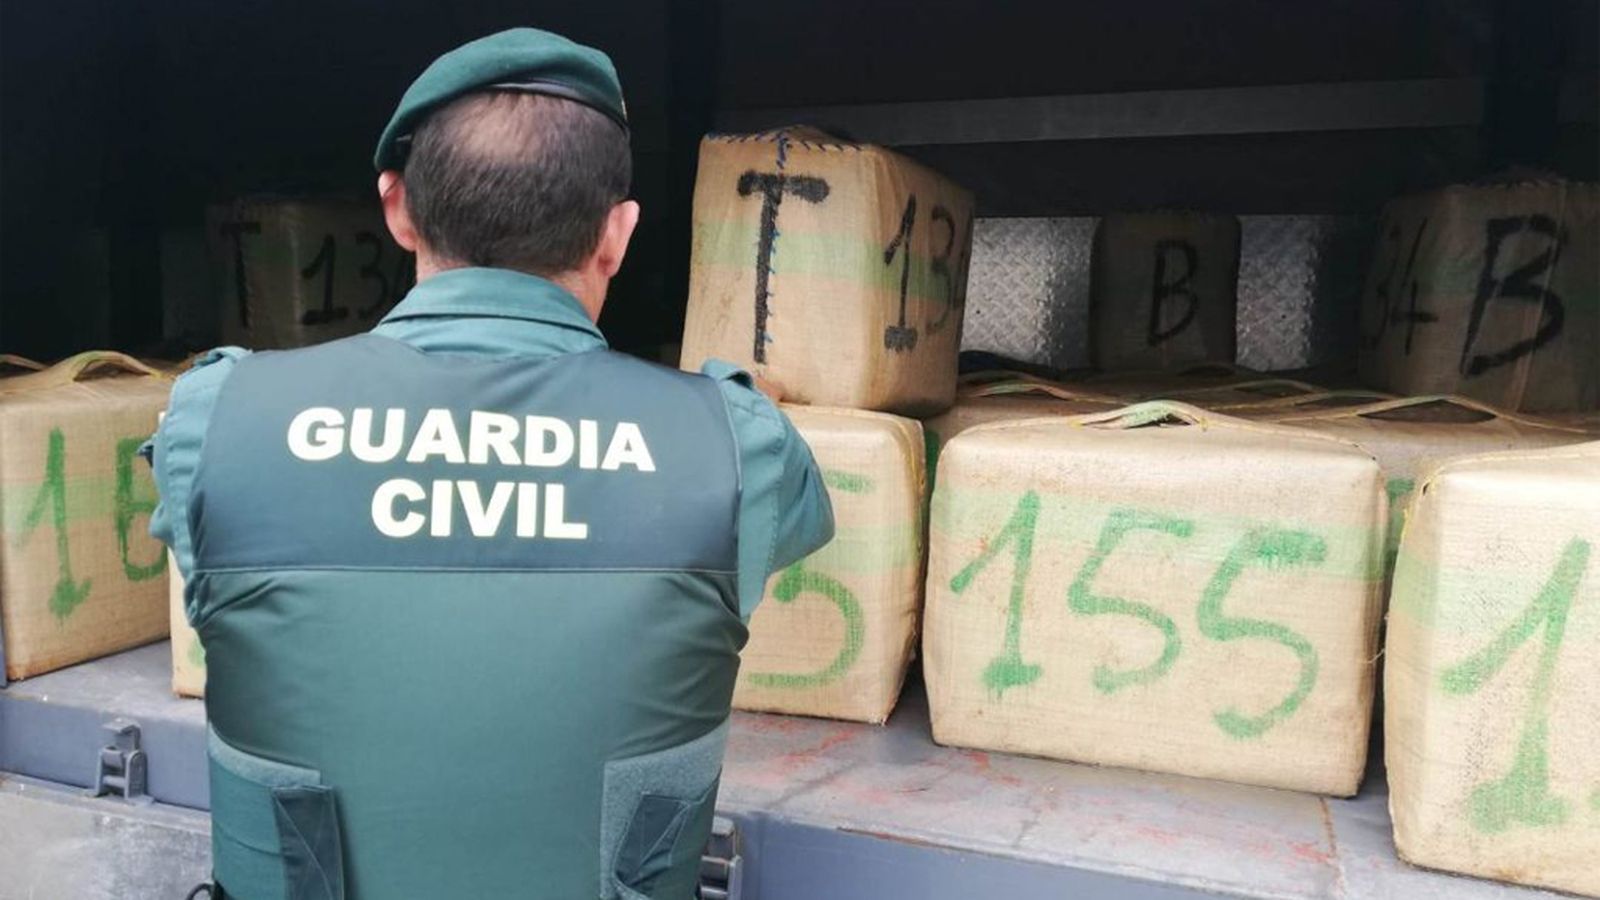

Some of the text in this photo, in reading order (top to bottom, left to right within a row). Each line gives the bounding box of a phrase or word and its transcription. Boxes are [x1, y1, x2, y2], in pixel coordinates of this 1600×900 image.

[219, 221, 261, 330] T
[736, 170, 829, 364] T
[1147, 239, 1199, 347] B
[1459, 213, 1566, 377] B
[287, 406, 656, 472] GUARDIA
[371, 478, 588, 540] CIVIL
[949, 489, 1328, 740] 155
